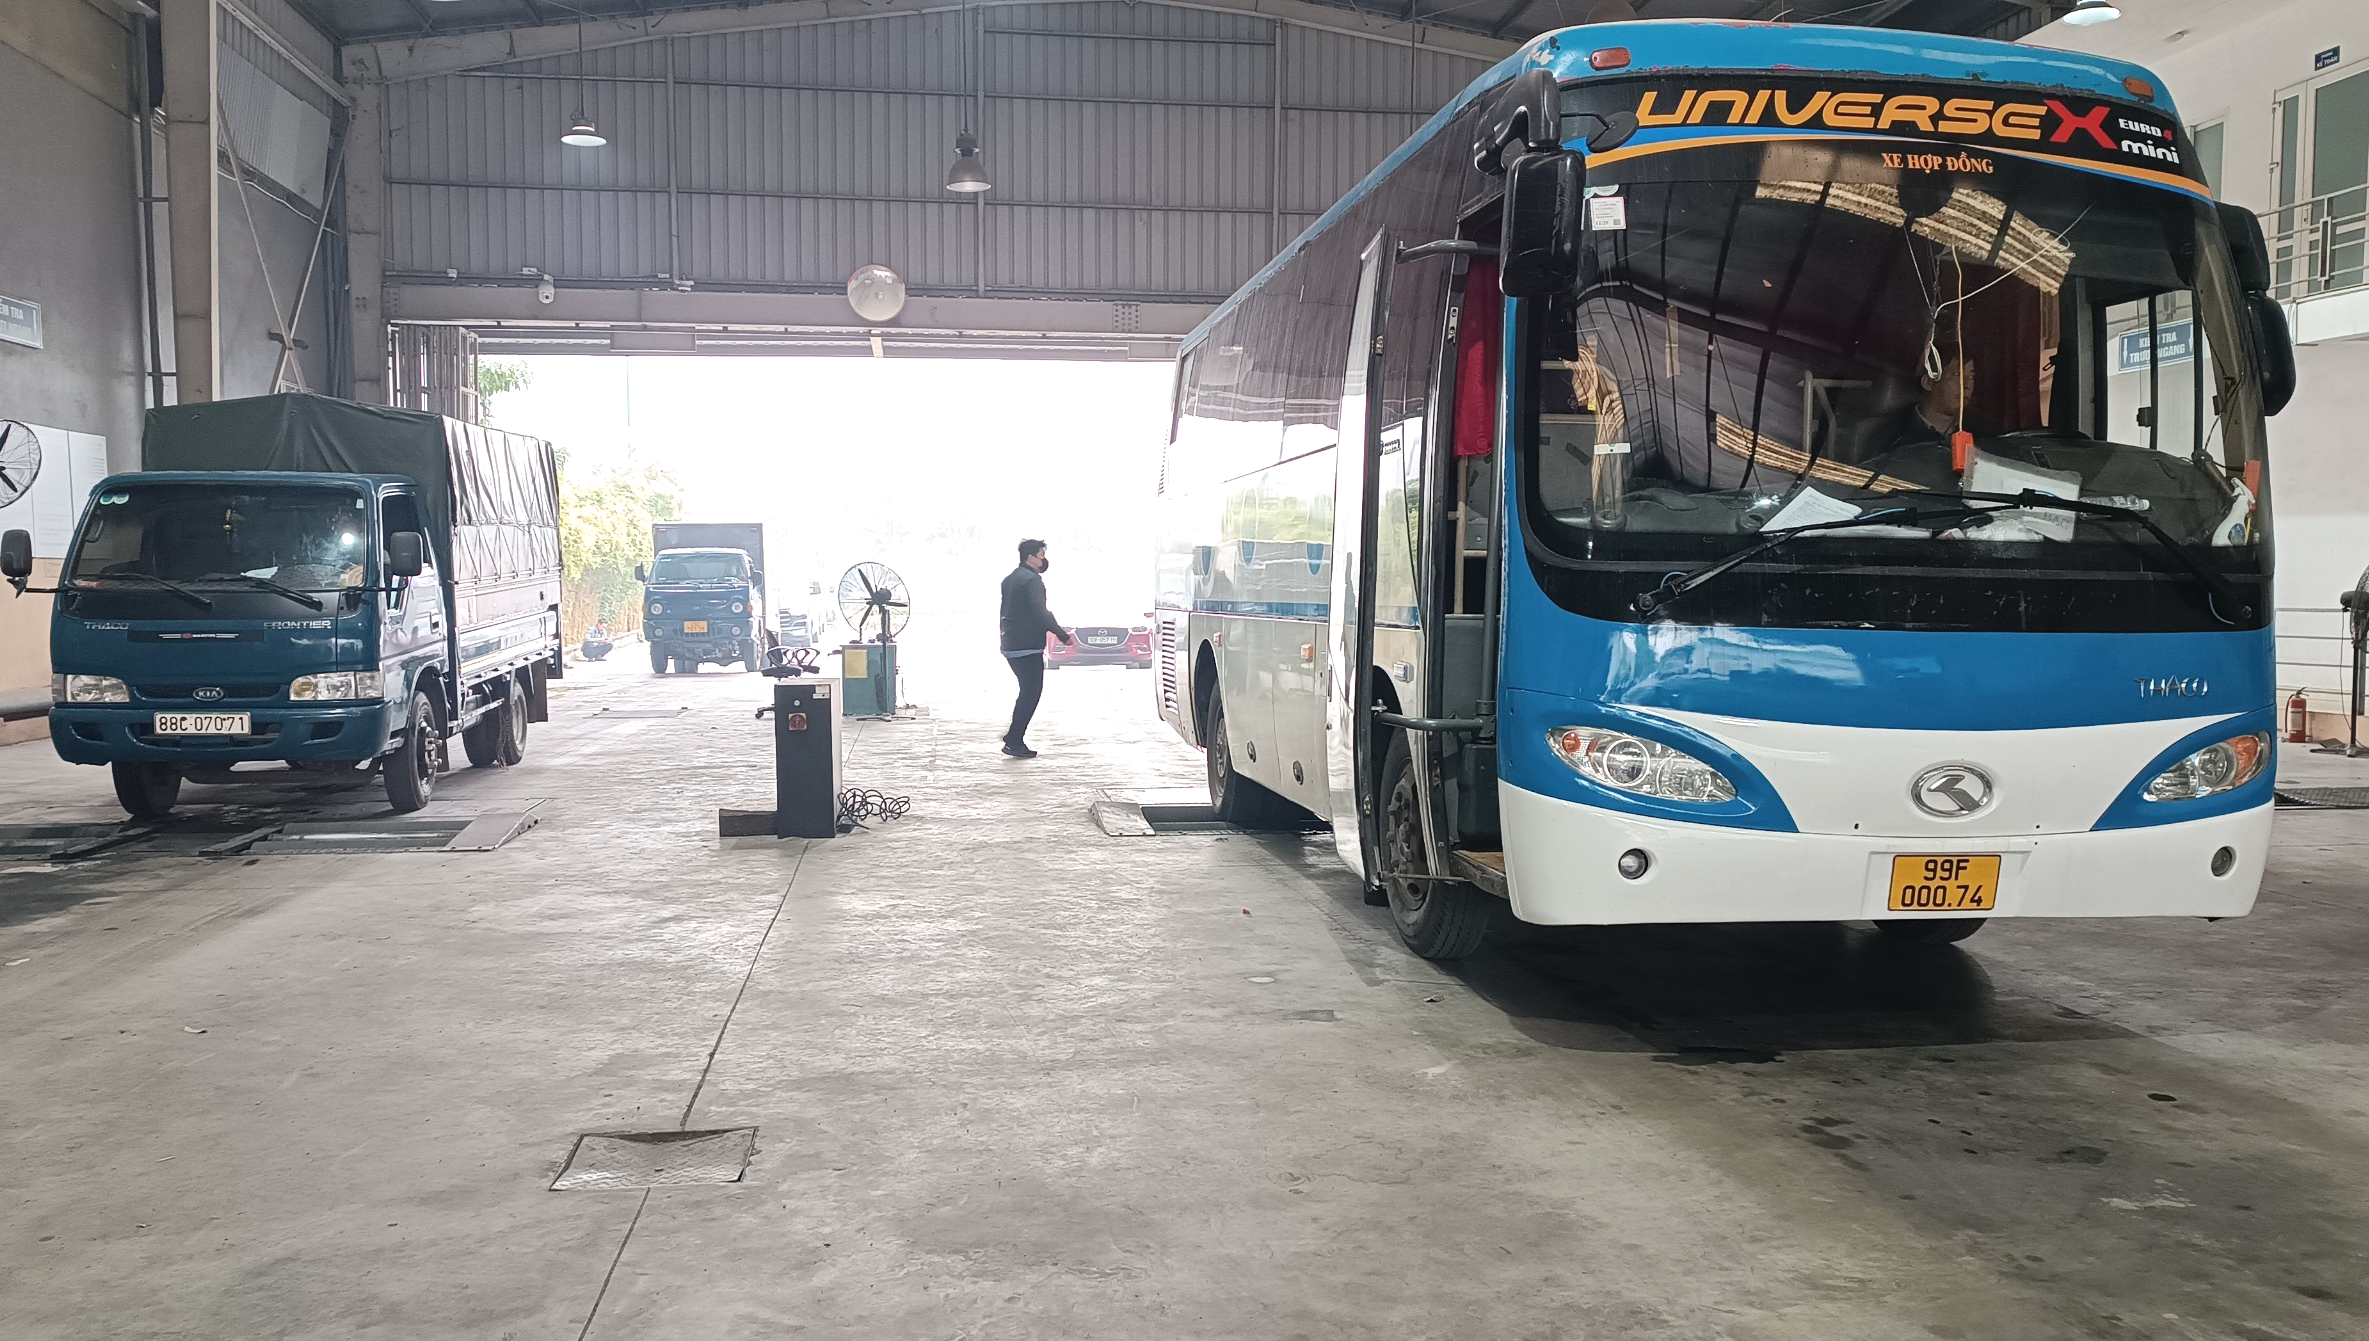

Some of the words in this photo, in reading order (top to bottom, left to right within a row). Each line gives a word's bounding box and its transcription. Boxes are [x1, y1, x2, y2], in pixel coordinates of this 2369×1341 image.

[1881, 153, 1904, 168] XE
[1907, 153, 1942, 173] HỢP
[1946, 151, 1994, 174] ĐỒNG
[2121, 139, 2180, 164] mini
[2162, 331, 2177, 343] TRA
[263, 620, 332, 629] FRONTIER
[2134, 674, 2209, 698] THACO
[1923, 859, 1970, 881] 99F
[1901, 884, 1983, 907] 000.74
